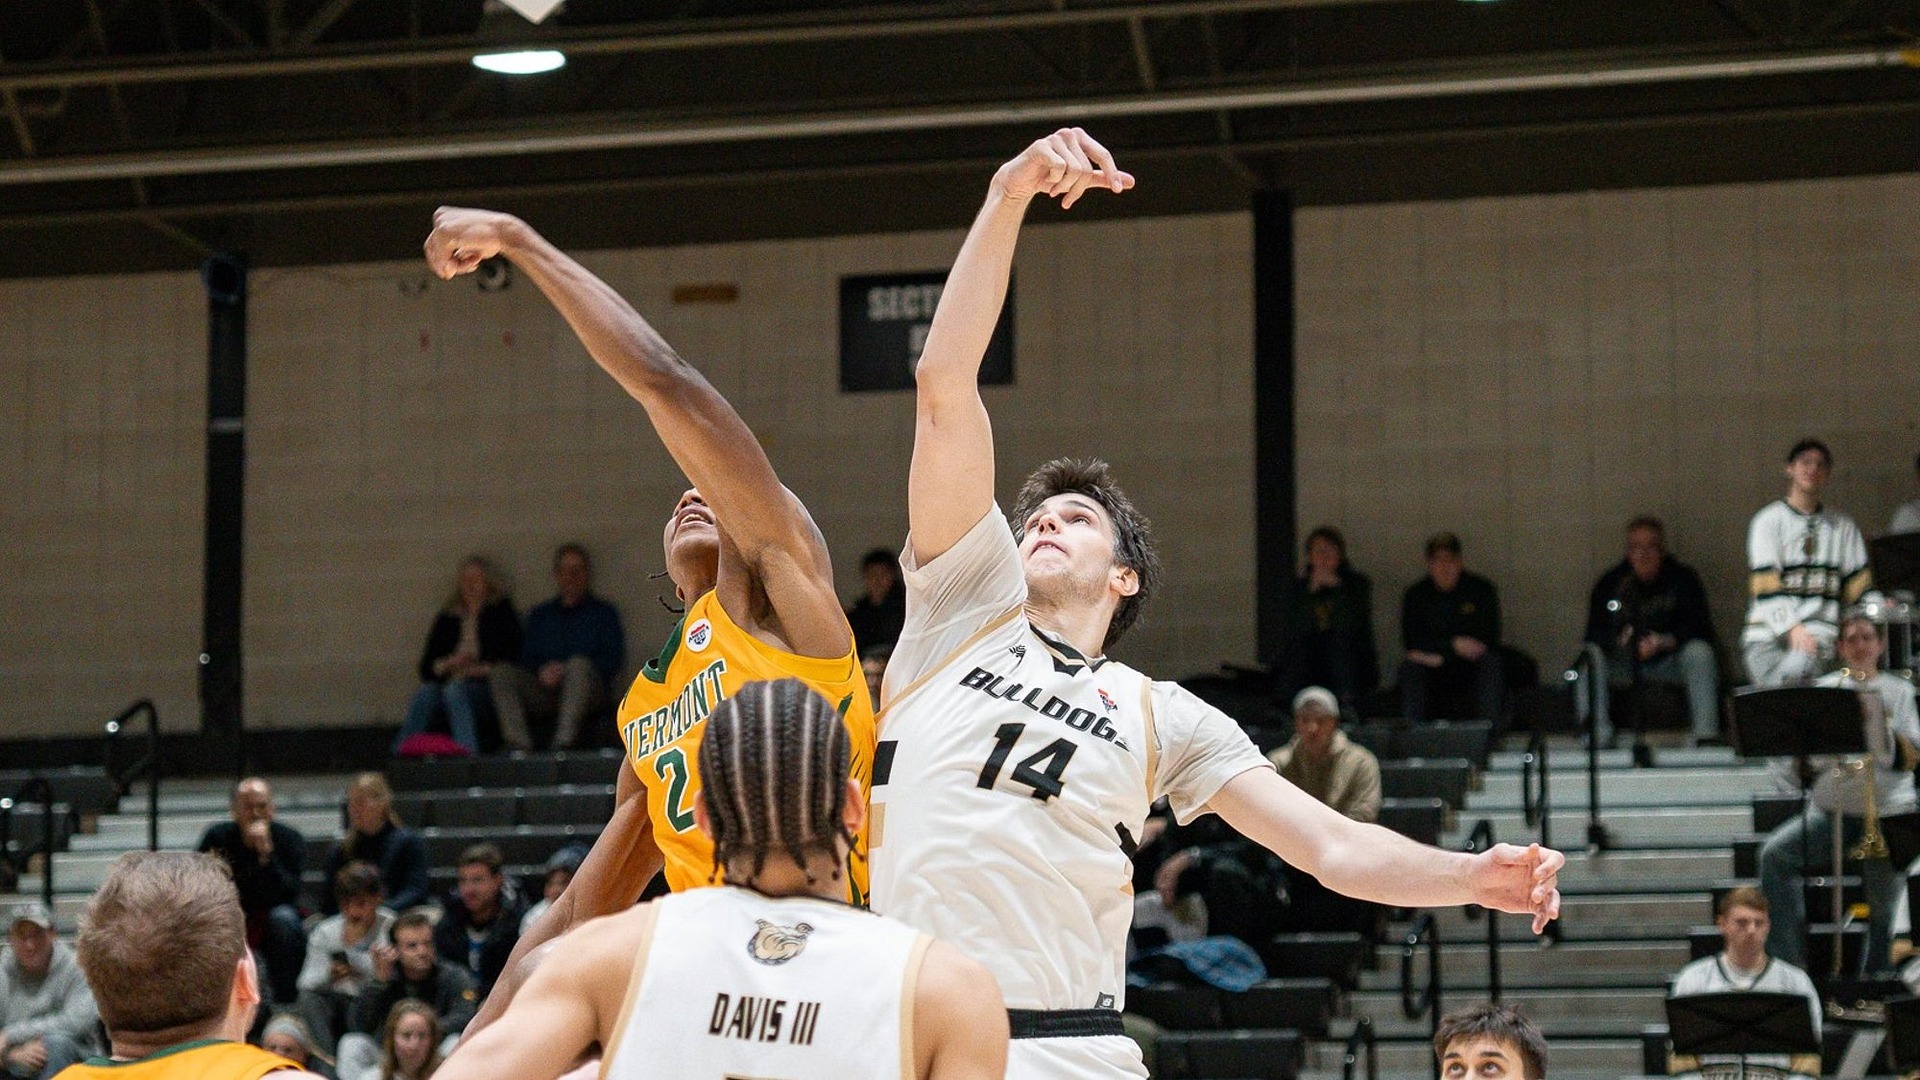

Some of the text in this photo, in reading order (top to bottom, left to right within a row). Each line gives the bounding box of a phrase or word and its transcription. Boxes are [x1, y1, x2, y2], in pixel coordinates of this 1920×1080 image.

[867, 284, 946, 321] SECT
[622, 657, 728, 763] VERMONT
[977, 722, 1079, 802] 14
[708, 992, 821, 1045] DAVIS III
